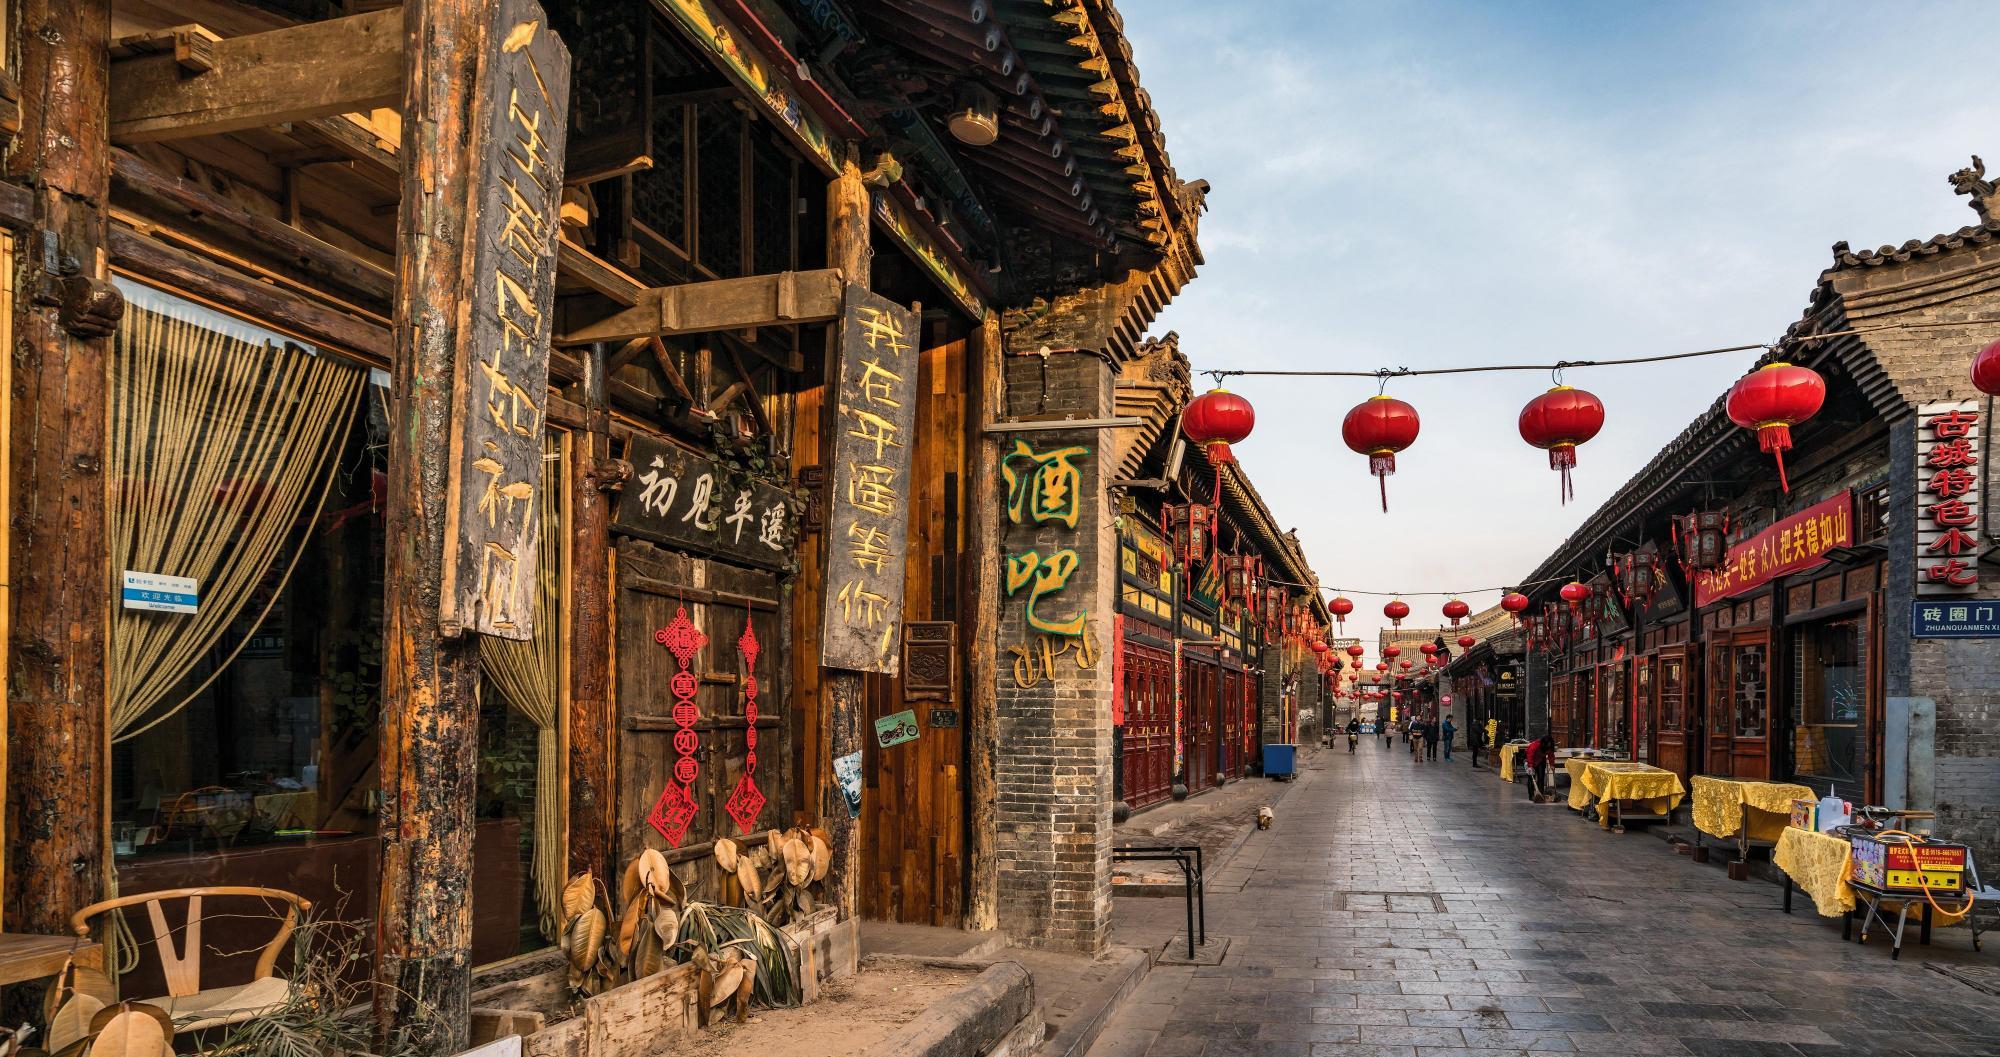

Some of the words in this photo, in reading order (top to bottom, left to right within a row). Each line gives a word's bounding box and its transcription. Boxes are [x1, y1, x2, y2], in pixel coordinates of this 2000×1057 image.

[638, 454, 785, 551] 初见平遥
[1001, 438, 1091, 637] 酒吧
[1927, 409, 1979, 586] 古城特色小吃
[1760, 505, 1847, 575] 众人把关稳如山
[1923, 606, 1993, 622] 砖圈门
[1925, 624, 1990, 632] ZHUANQUANMEN
